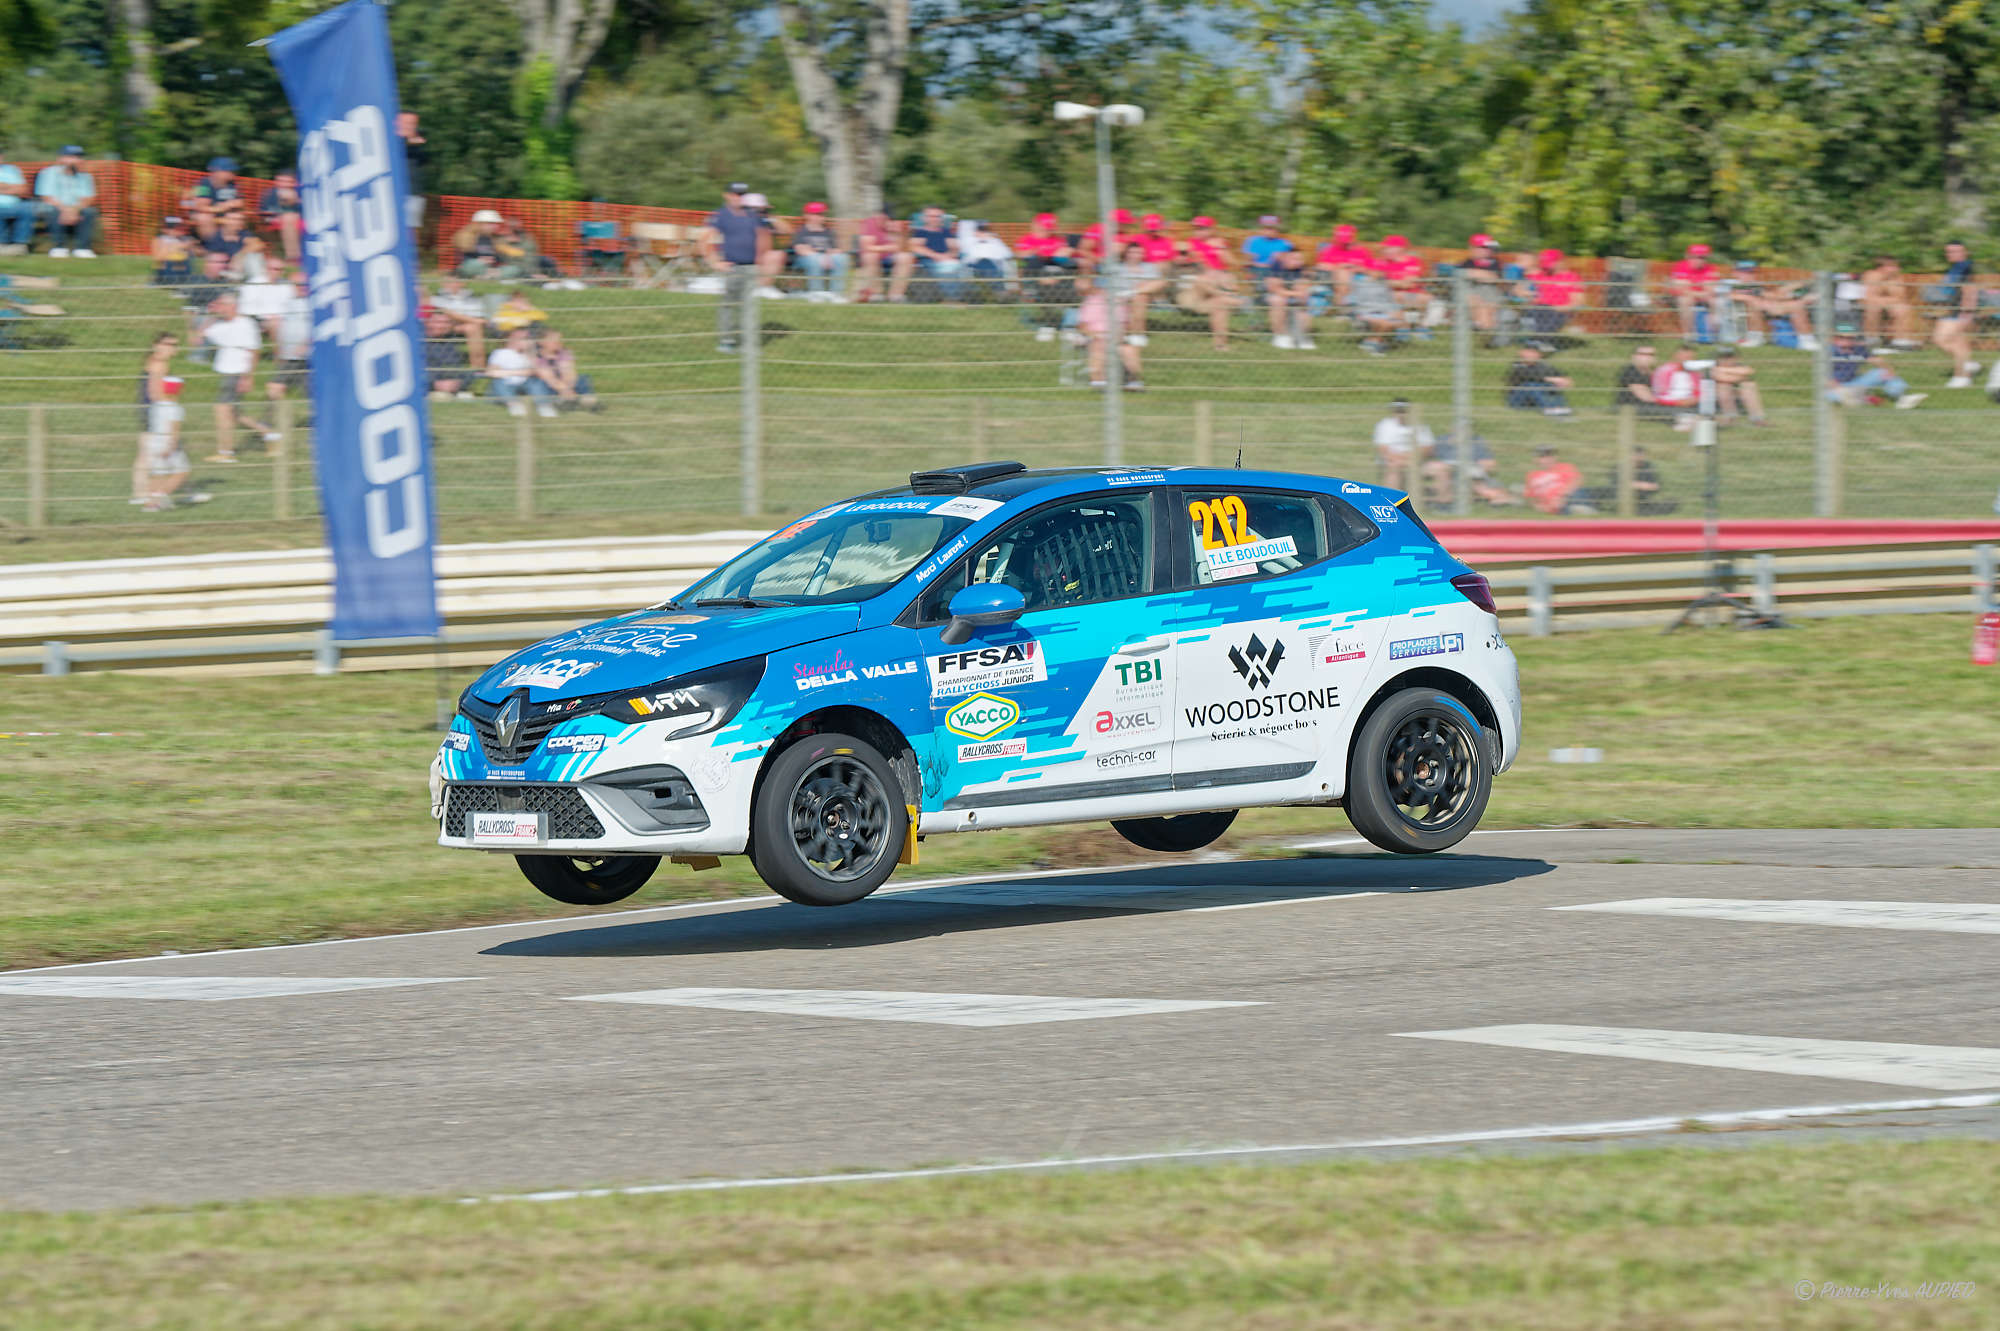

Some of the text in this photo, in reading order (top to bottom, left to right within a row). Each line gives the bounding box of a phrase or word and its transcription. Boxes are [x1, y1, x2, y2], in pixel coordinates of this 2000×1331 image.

[1188, 495, 1258, 551] 212
[915, 561, 937, 583] Merci
[936, 539, 965, 565] Laurent
[1235, 541, 1294, 561] BOUDOUIL
[1392, 640, 1407, 650] PRO
[1408, 638, 1437, 648] PLAQUES
[1392, 646, 1438, 659] SERVICES
[792, 649, 855, 679] Stanislas
[938, 644, 1026, 674] FFSA
[796, 661, 918, 690] DELLA VALLE
[937, 673, 993, 687] CHAMPIONNAT
[1005, 666, 1034, 676] FRANCE
[1114, 658, 1163, 686] TBI
[937, 674, 1034, 696] RALLYCROSS JUNIOR
[955, 706, 1011, 727] YACCO
[1184, 685, 1341, 728] WOODSTONE
[1210, 719, 1318, 742] Scierie & négoce bos
[547, 734, 606, 749] COOPER
[961, 743, 1004, 758] RALLYCROSS
[1096, 750, 1157, 768] techni-car
[478, 820, 516, 834] RALLYCROSS
